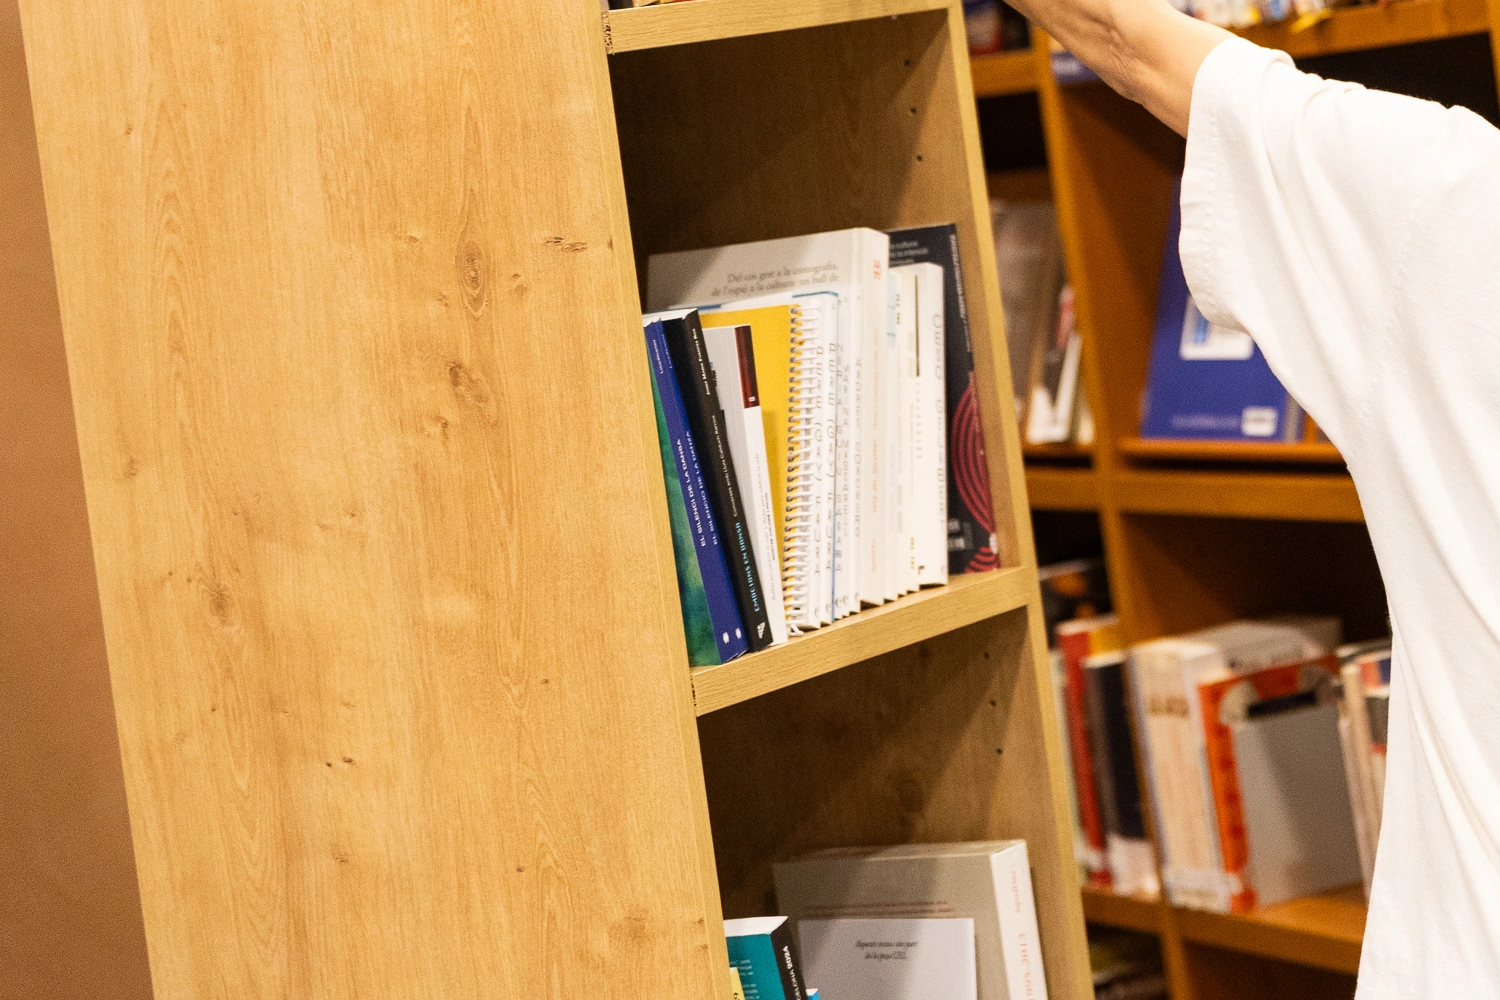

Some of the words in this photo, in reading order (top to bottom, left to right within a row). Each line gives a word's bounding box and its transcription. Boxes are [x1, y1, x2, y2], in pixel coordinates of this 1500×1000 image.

[677, 438, 688, 469] DANSA
[693, 461, 700, 474] LA
[682, 470, 691, 483] LA
[696, 474, 704, 489] DE
[686, 483, 694, 498] DE
[690, 497, 703, 533] SILENCI
[698, 534, 706, 547] EL
[710, 532, 718, 545] EL
[742, 551, 750, 564] EN
[780, 944, 794, 970] 2024
